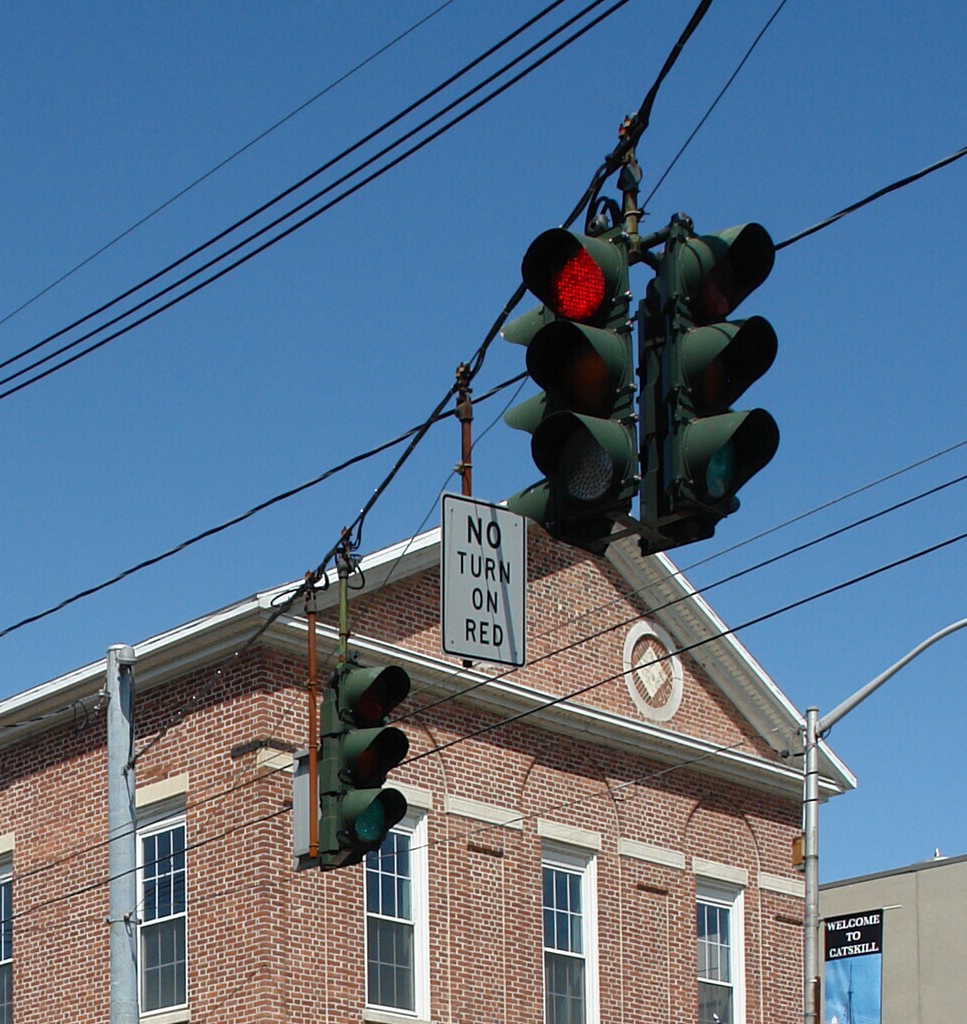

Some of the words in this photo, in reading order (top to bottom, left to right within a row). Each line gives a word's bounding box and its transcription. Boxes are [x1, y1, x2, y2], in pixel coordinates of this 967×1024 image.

[467, 515, 502, 549] NO
[457, 551, 511, 584] TURN
[472, 587, 498, 614] ON
[465, 618, 504, 647] RED
[827, 914, 880, 931] WELCOME
[829, 942, 879, 958] CATSKILL
[845, 931, 861, 942] TO
